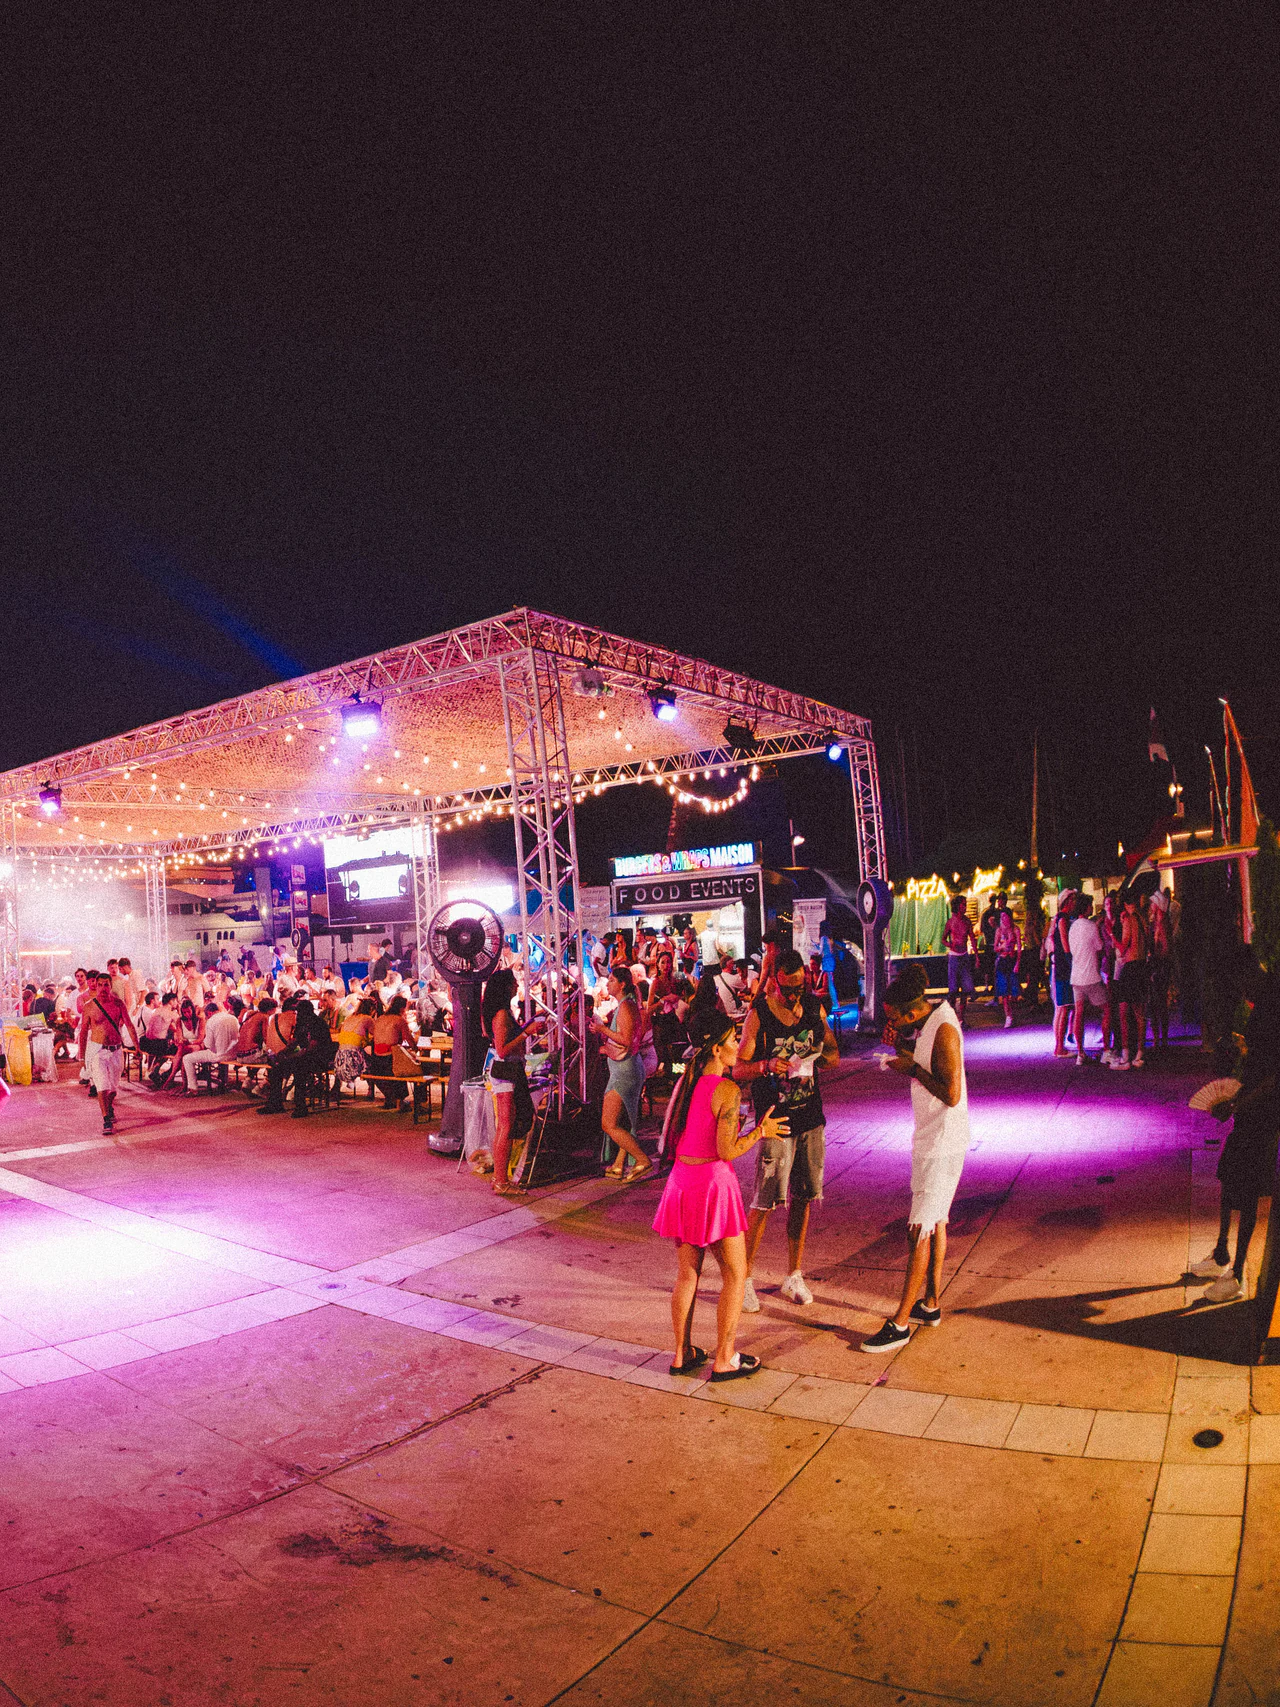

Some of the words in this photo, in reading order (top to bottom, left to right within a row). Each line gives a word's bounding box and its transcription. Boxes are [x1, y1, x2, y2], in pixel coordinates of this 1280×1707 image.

[710, 843, 754, 867] MAISON
[620, 886, 680, 903] FOOD
[690, 877, 755, 898] EVENTS
[907, 880, 949, 899] PIZZA
